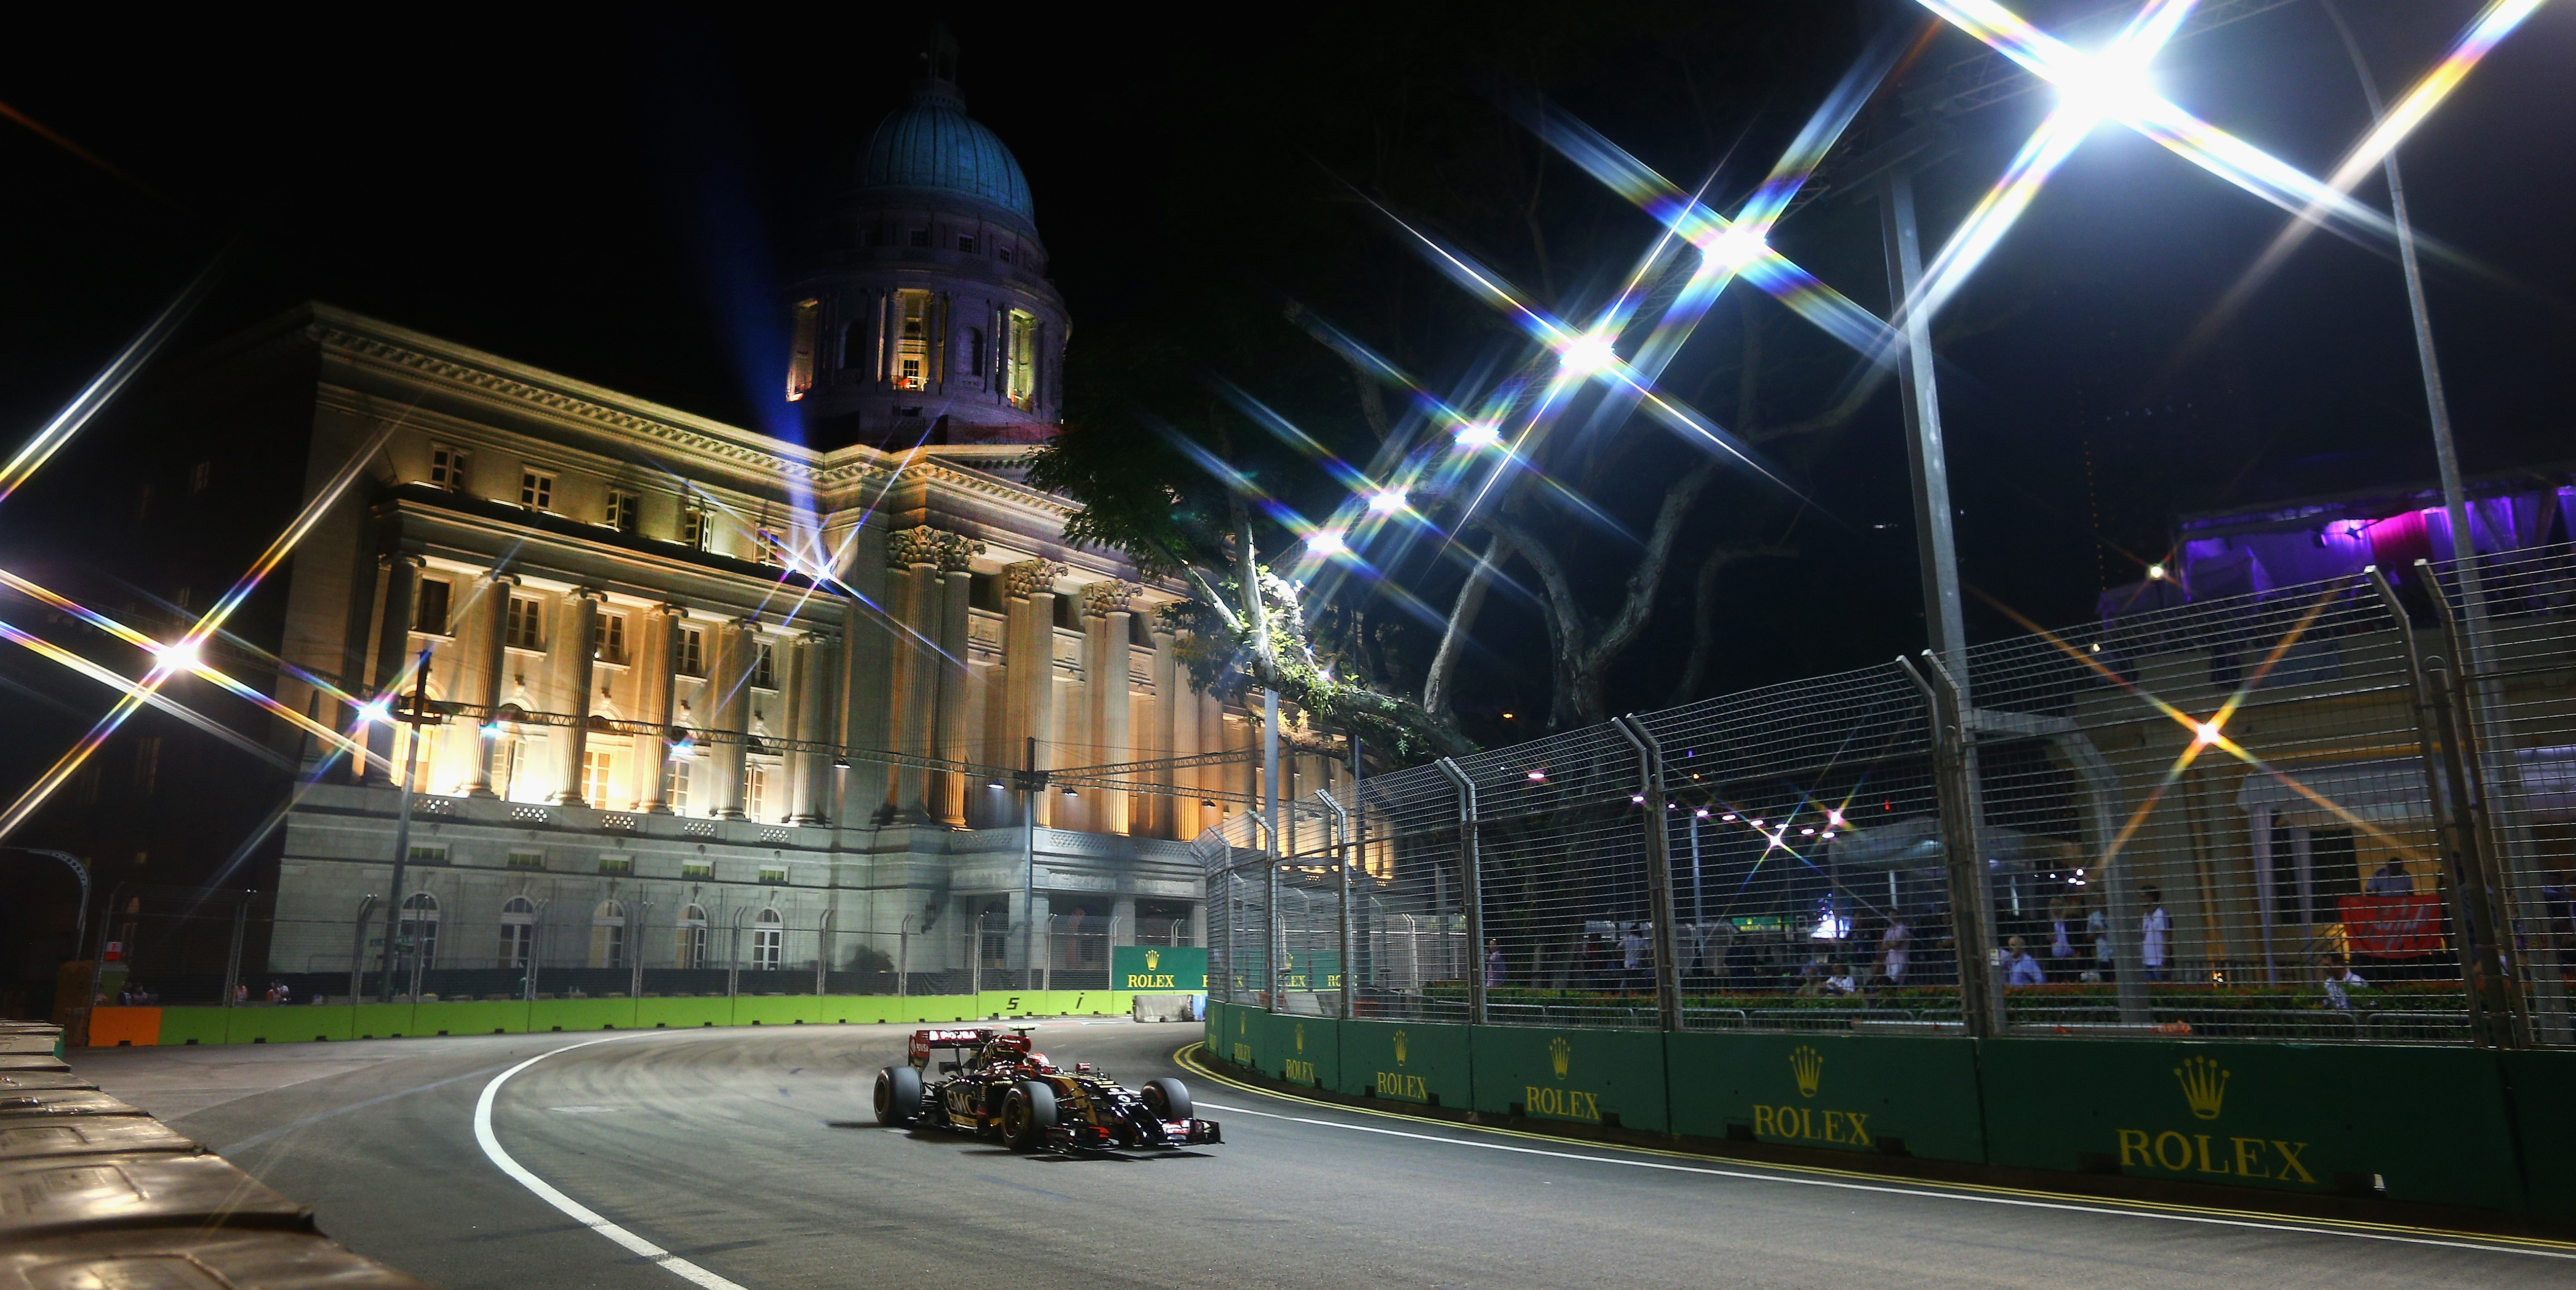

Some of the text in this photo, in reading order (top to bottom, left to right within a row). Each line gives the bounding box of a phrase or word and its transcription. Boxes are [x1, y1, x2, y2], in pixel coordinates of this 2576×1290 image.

[1128, 974, 1175, 988] ROLEX
[1286, 1058, 1315, 1083] ROLEX
[1377, 1072, 1428, 1100] ROLEX
[1526, 1086, 1601, 1120] ROLEX
[1754, 1104, 1872, 1147] ROLEX
[2118, 1129, 2317, 1184] ROLEX
